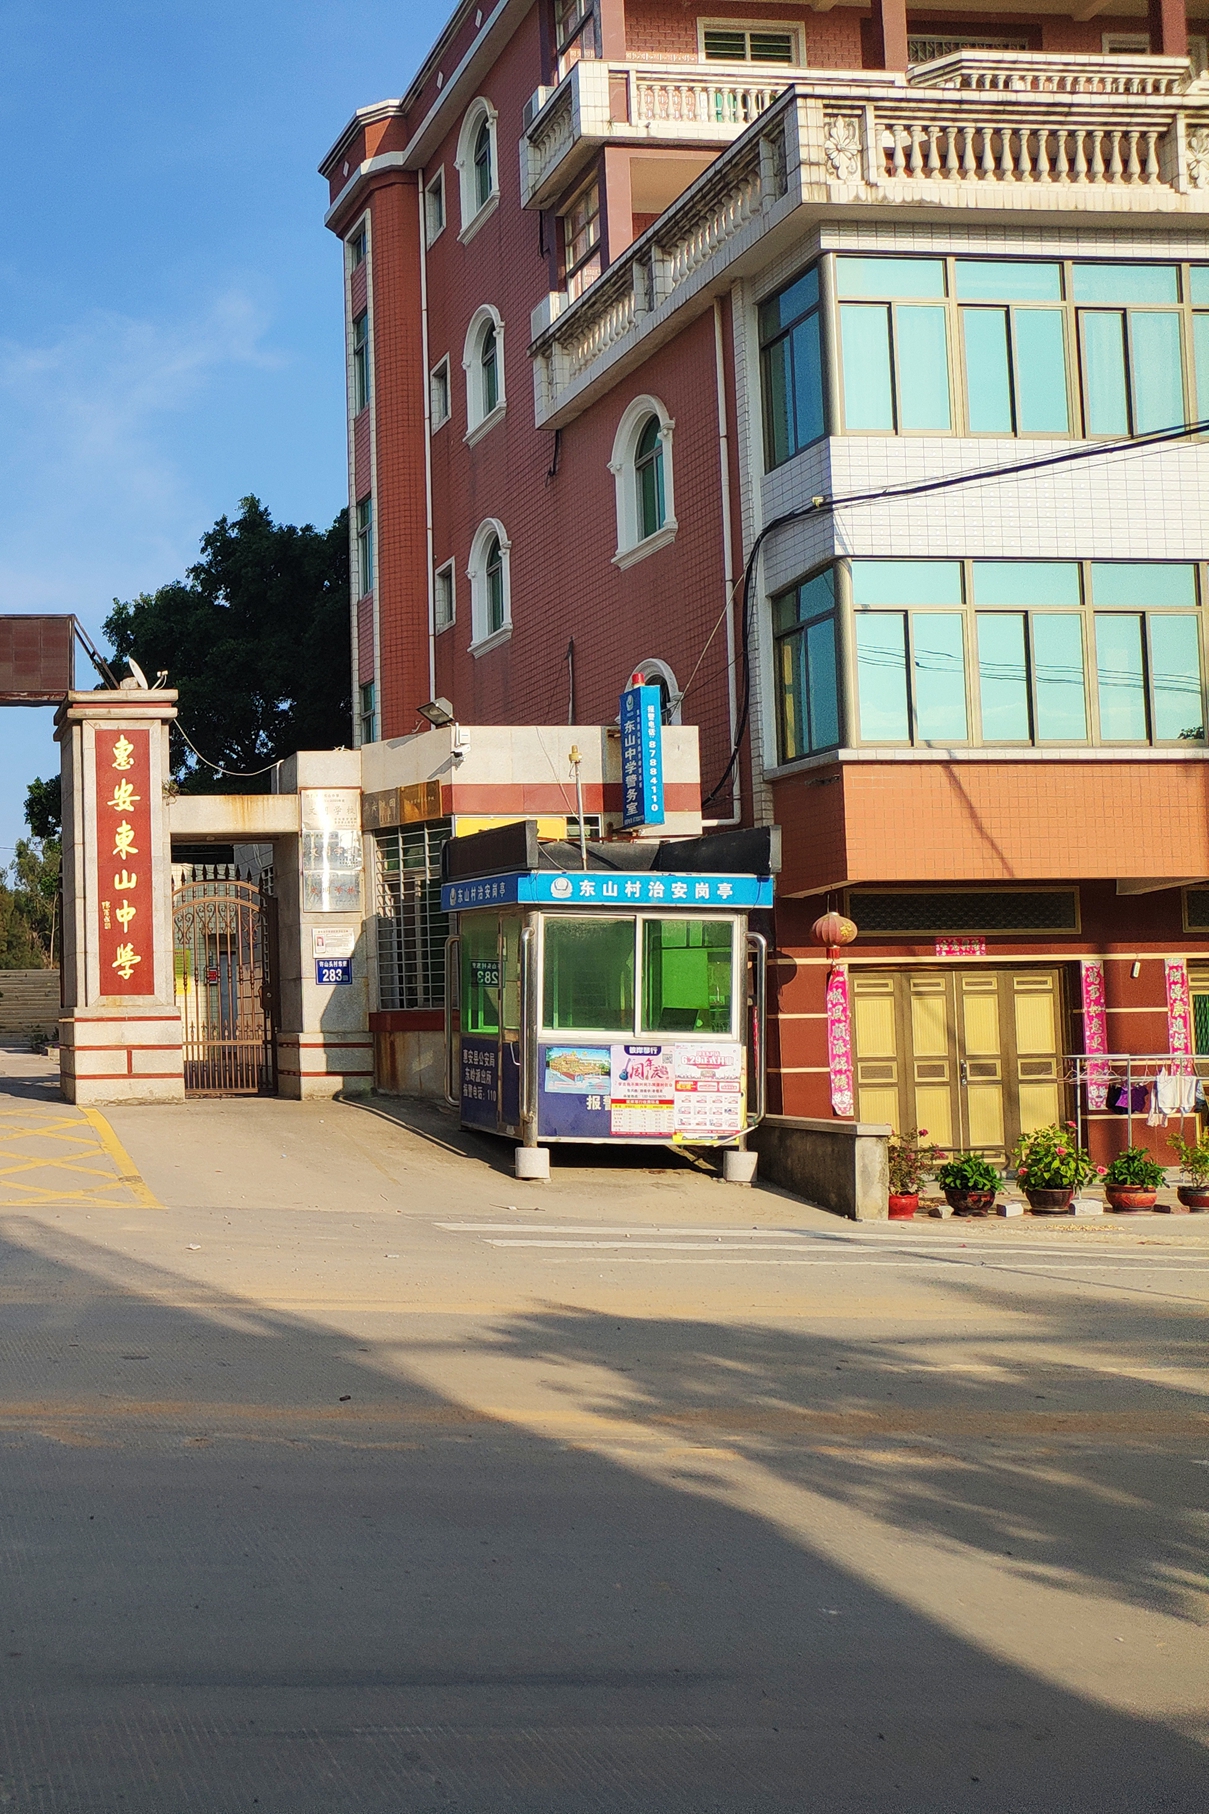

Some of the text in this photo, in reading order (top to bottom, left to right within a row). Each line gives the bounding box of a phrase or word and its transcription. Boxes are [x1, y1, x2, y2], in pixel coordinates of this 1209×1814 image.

[624, 720, 638, 816] 东山中学警务室
[308, 805, 356, 815] 文学校
[457, 882, 506, 904] 东山村治安岗亭
[579, 880, 733, 899] 东山村治安岗亭
[322, 969, 342, 982] 283
[463, 1049, 495, 1067] 惠安县公安局
